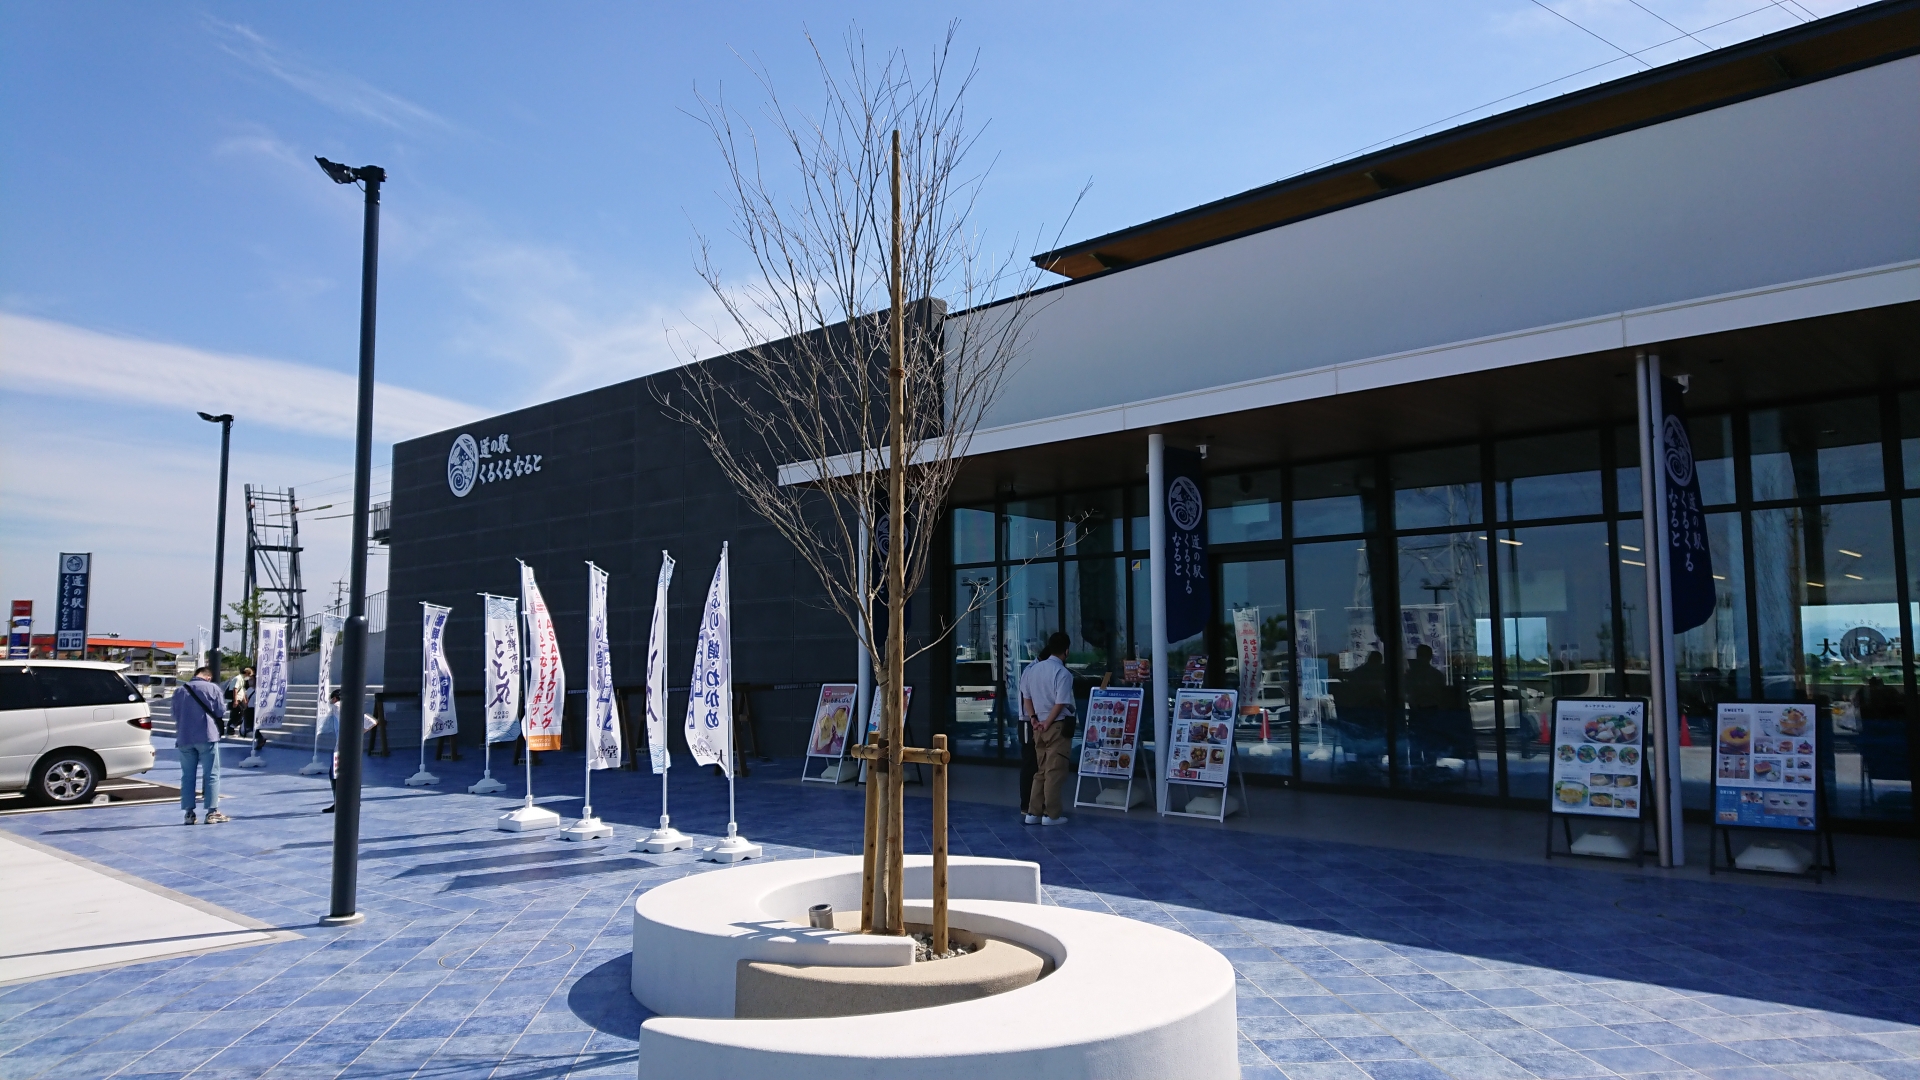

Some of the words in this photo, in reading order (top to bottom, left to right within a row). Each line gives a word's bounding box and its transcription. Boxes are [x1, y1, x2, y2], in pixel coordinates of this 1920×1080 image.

[479, 433, 511, 459] 道の駅
[479, 454, 543, 485] くるくるなると
[1668, 489, 1681, 547] なると
[1681, 490, 1694, 572] くるくる
[1688, 492, 1705, 551] 道の駅
[1172, 534, 1182, 576] なると
[1183, 533, 1193, 595] くるくる
[1191, 534, 1204, 579] 道の駅
[61, 574, 70, 629] くるくるなると
[70, 575, 85, 609] 道の駅
[504, 623, 519, 675] 海鮮市場
[541, 619, 559, 730] ASAサイクリング
